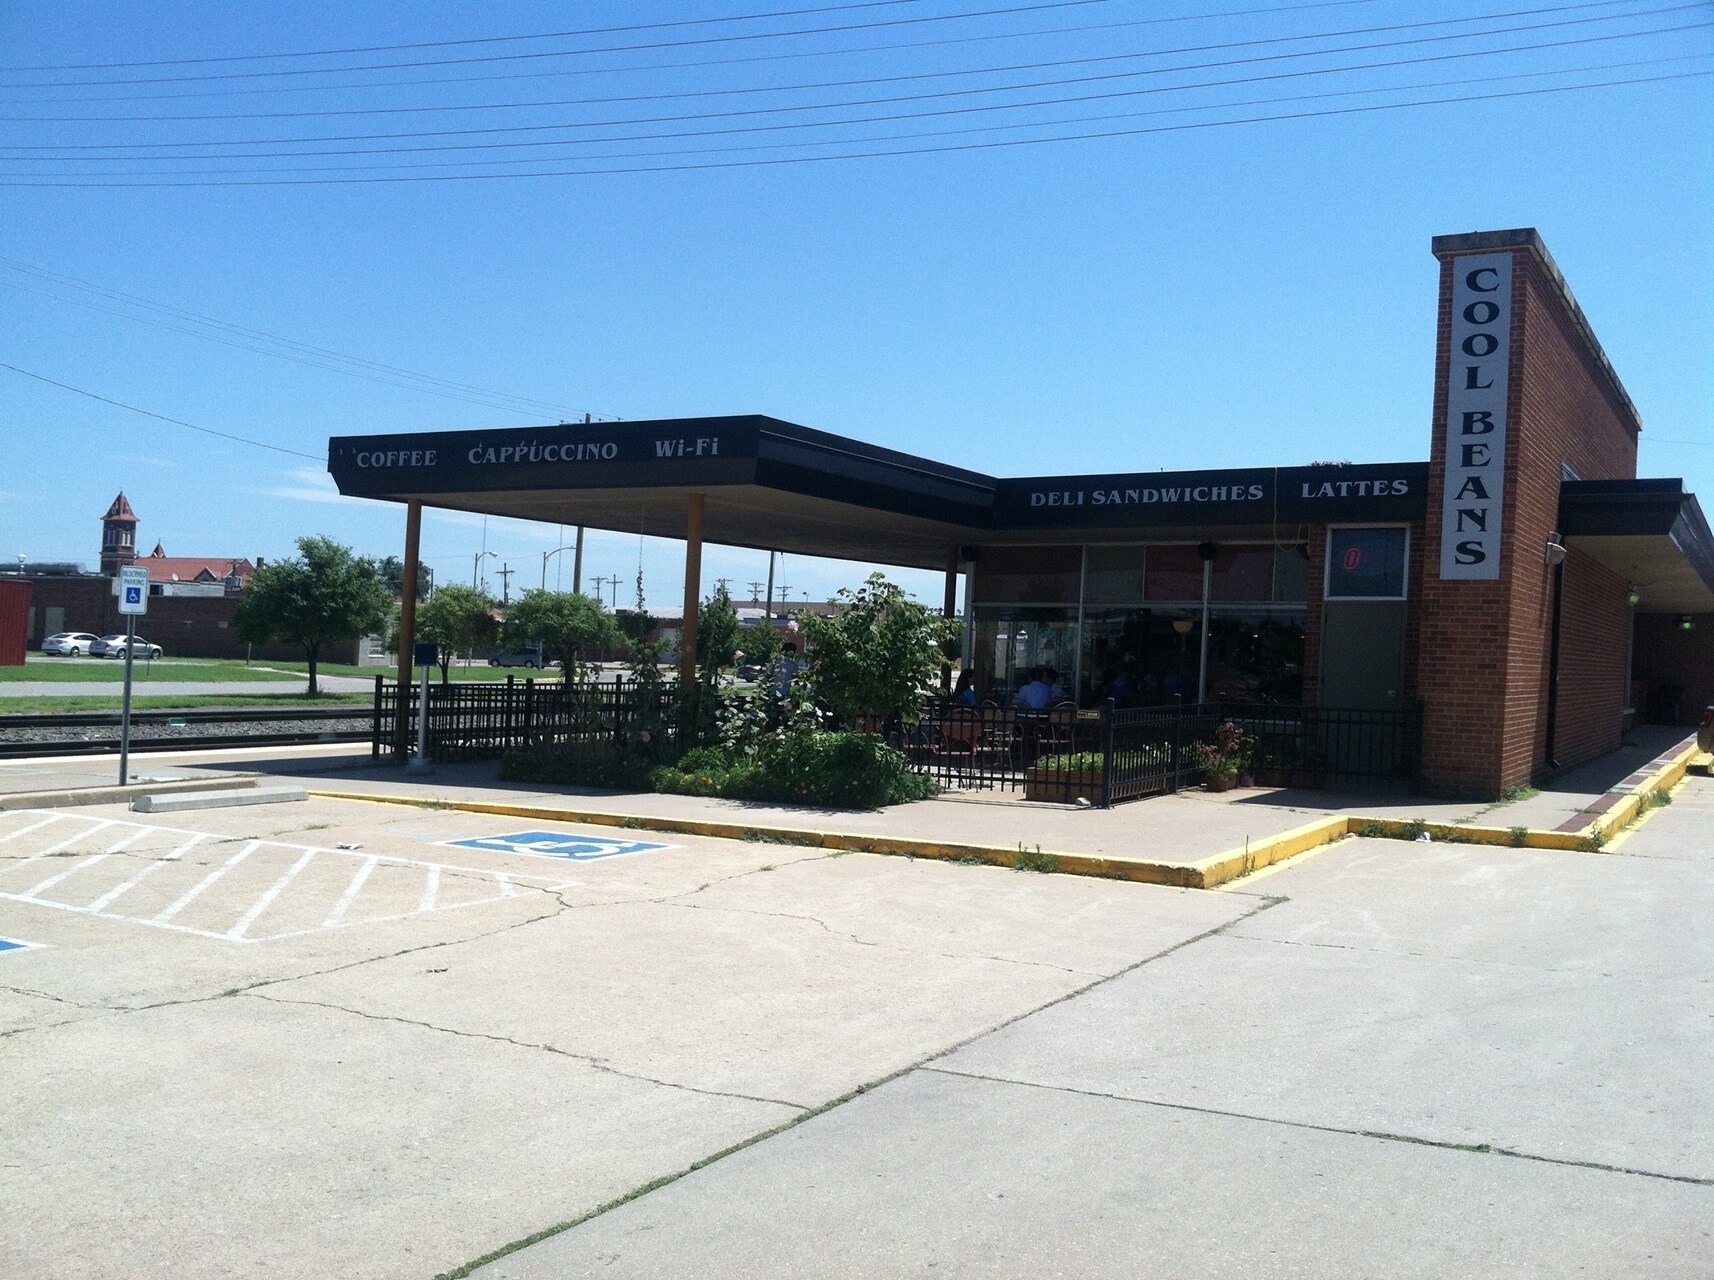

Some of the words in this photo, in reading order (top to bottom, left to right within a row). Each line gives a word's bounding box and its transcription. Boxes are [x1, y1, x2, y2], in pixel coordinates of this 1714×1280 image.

[1461, 267, 1500, 390] COOL
[468, 442, 618, 464] CAPPUCCINO
[654, 437, 719, 458] Wi-Fi
[356, 449, 437, 468] COFFEE
[1030, 491, 1084, 507] DELI
[1091, 484, 1264, 506] SANDWICHES
[1301, 478, 1409, 499] LATTES
[1453, 410, 1495, 566] BEANS
[122, 570, 147, 578] RESERVED
[123, 578, 145, 586] PARKING
